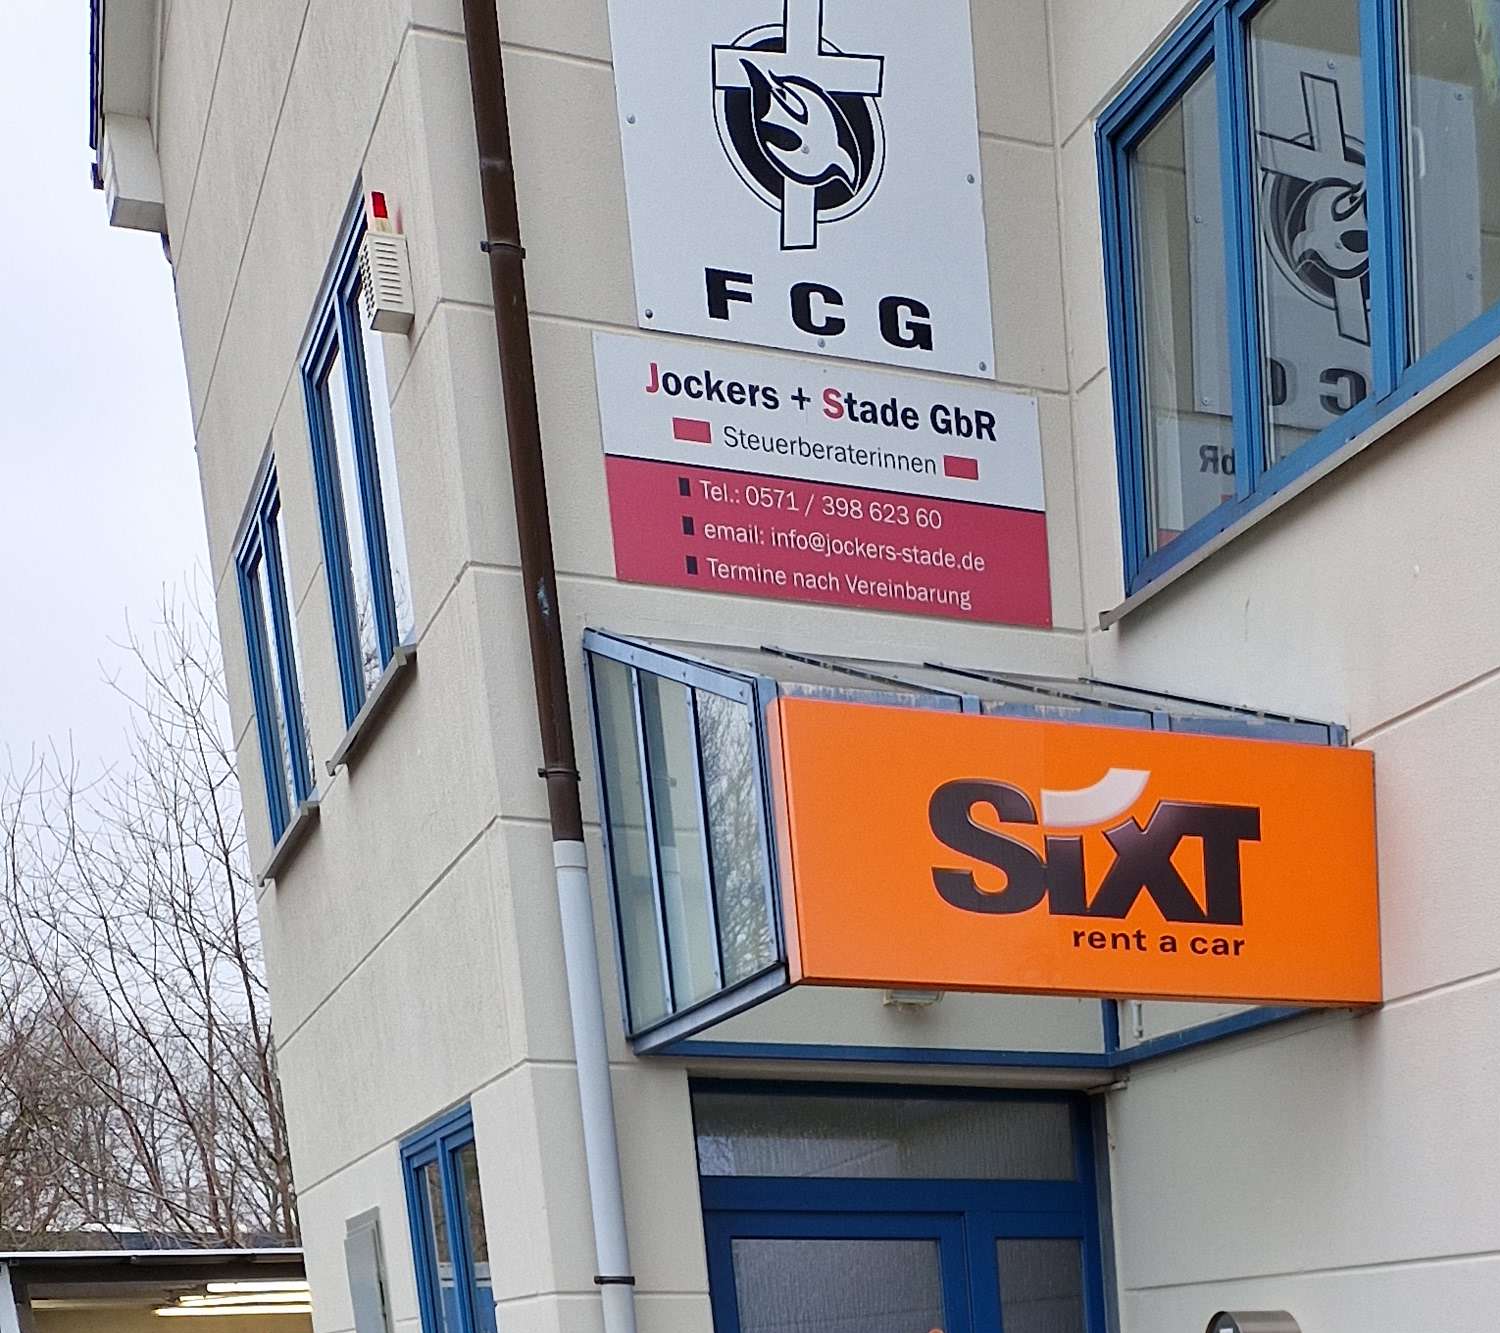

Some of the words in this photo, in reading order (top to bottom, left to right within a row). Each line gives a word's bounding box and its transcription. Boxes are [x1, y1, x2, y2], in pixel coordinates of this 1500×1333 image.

[645, 362, 780, 410] Jockers
[791, 387, 812, 411] +
[822, 388, 920, 430] Stade
[930, 403, 997, 442] GbR
[723, 425, 937, 475] Steuerberaterinnen
[699, 480, 740, 504] Tel.:
[745, 486, 799, 511] 0571
[822, 495, 864, 519] 398
[869, 502, 910, 525] 623
[915, 508, 942, 529] 60
[704, 522, 765, 545] email:
[771, 527, 986, 571] info@jockers-stade.de
[706, 557, 787, 585] Termine
[792, 570, 840, 592] nach
[844, 576, 972, 610] Vereinbarung
[1073, 929, 1147, 951] rent
[1159, 934, 1177, 953] a
[1189, 936, 1245, 956] car
